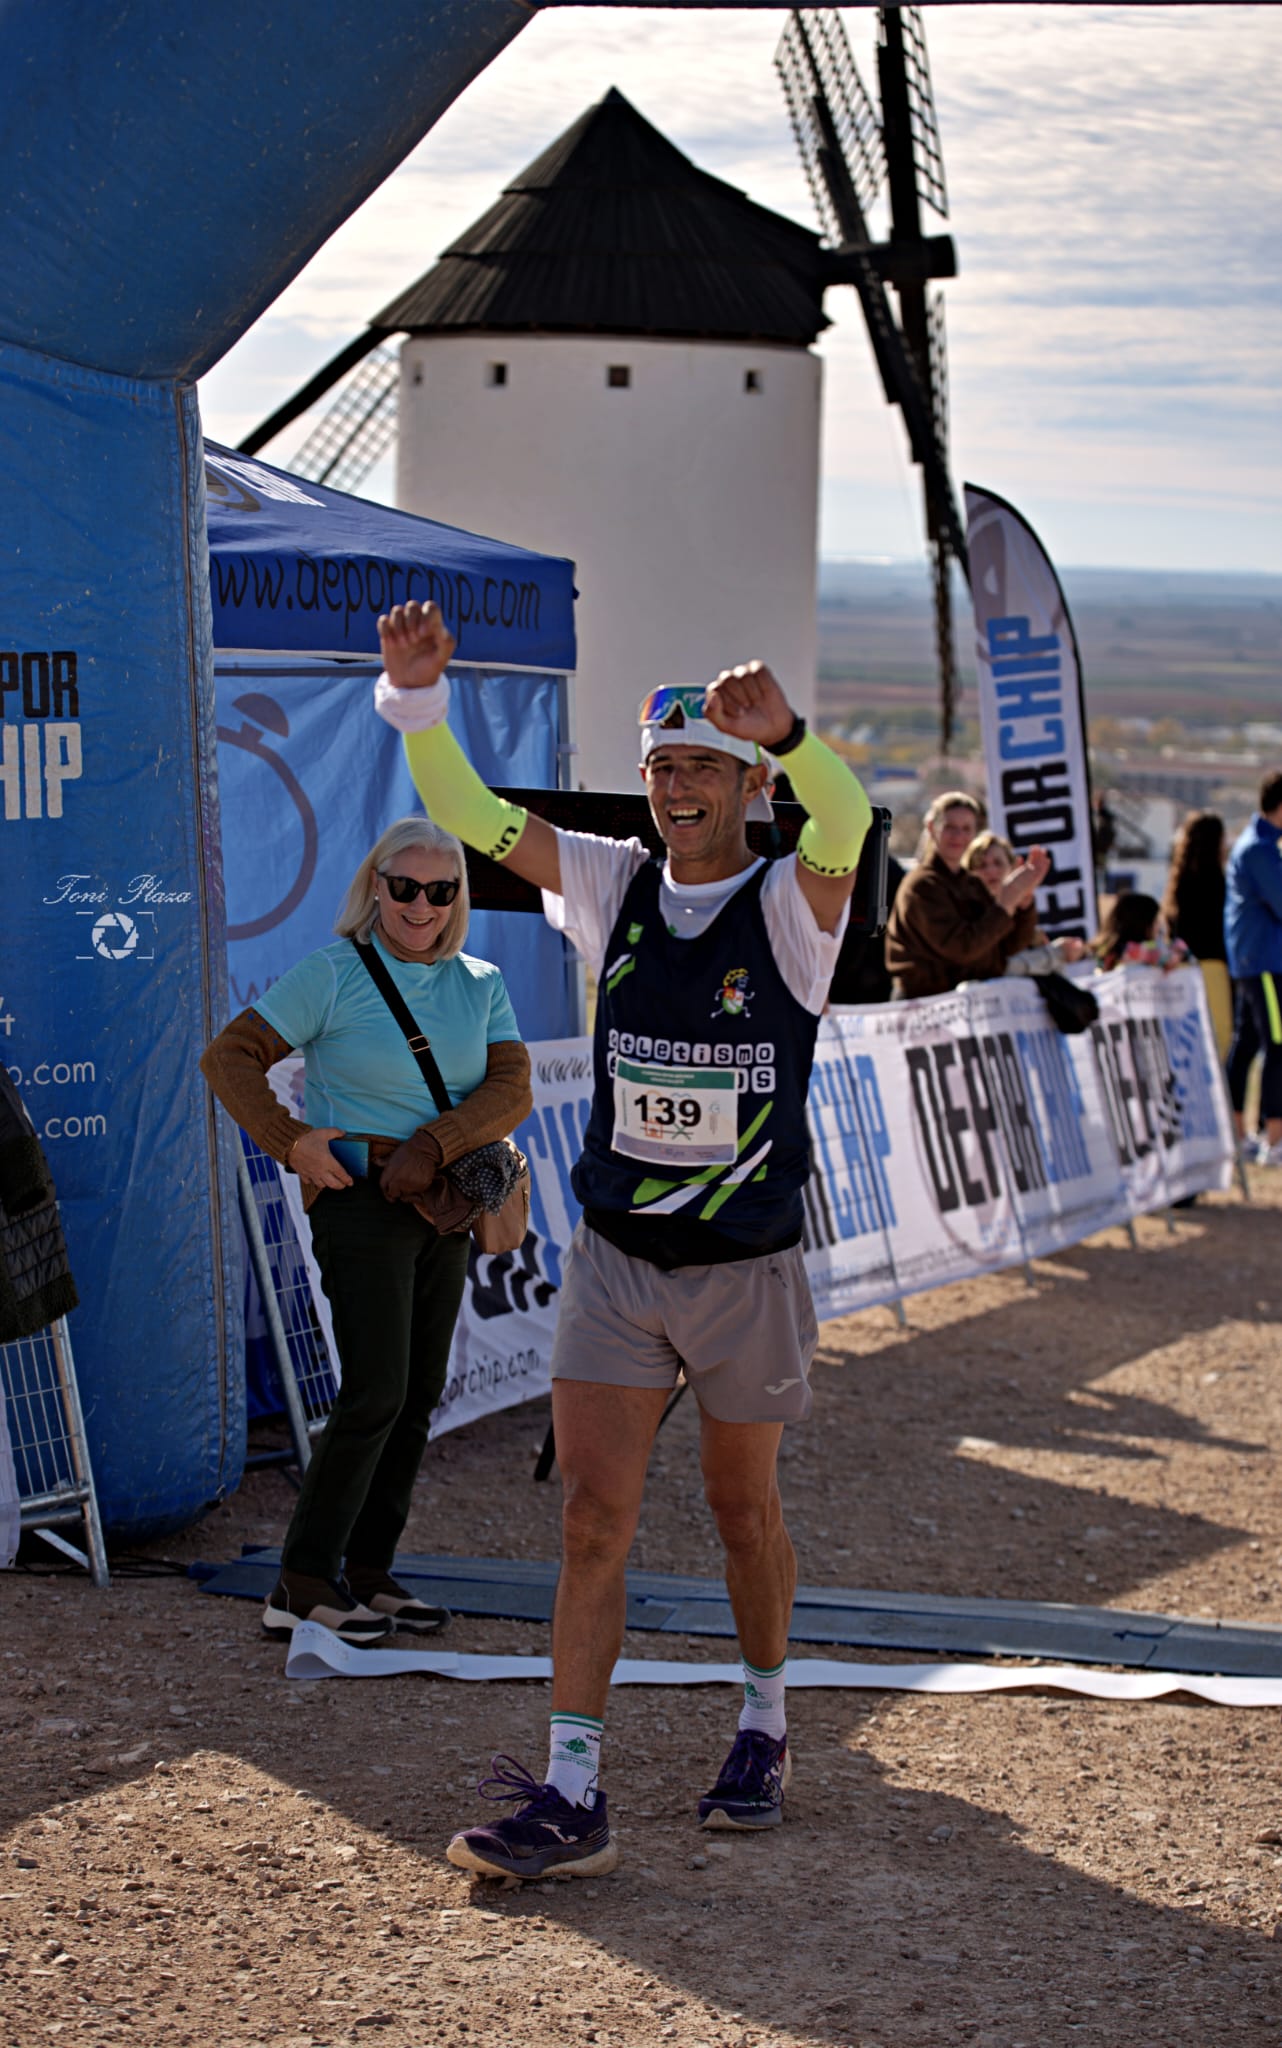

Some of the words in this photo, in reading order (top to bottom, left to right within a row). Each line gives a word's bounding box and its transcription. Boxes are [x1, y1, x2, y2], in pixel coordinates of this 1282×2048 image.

[209, 547, 542, 648] ww.deporchip.com
[986, 616, 1088, 942] EPORCHIP
[634, 1094, 702, 1127] 139
[801, 1054, 898, 1253] CHIP
